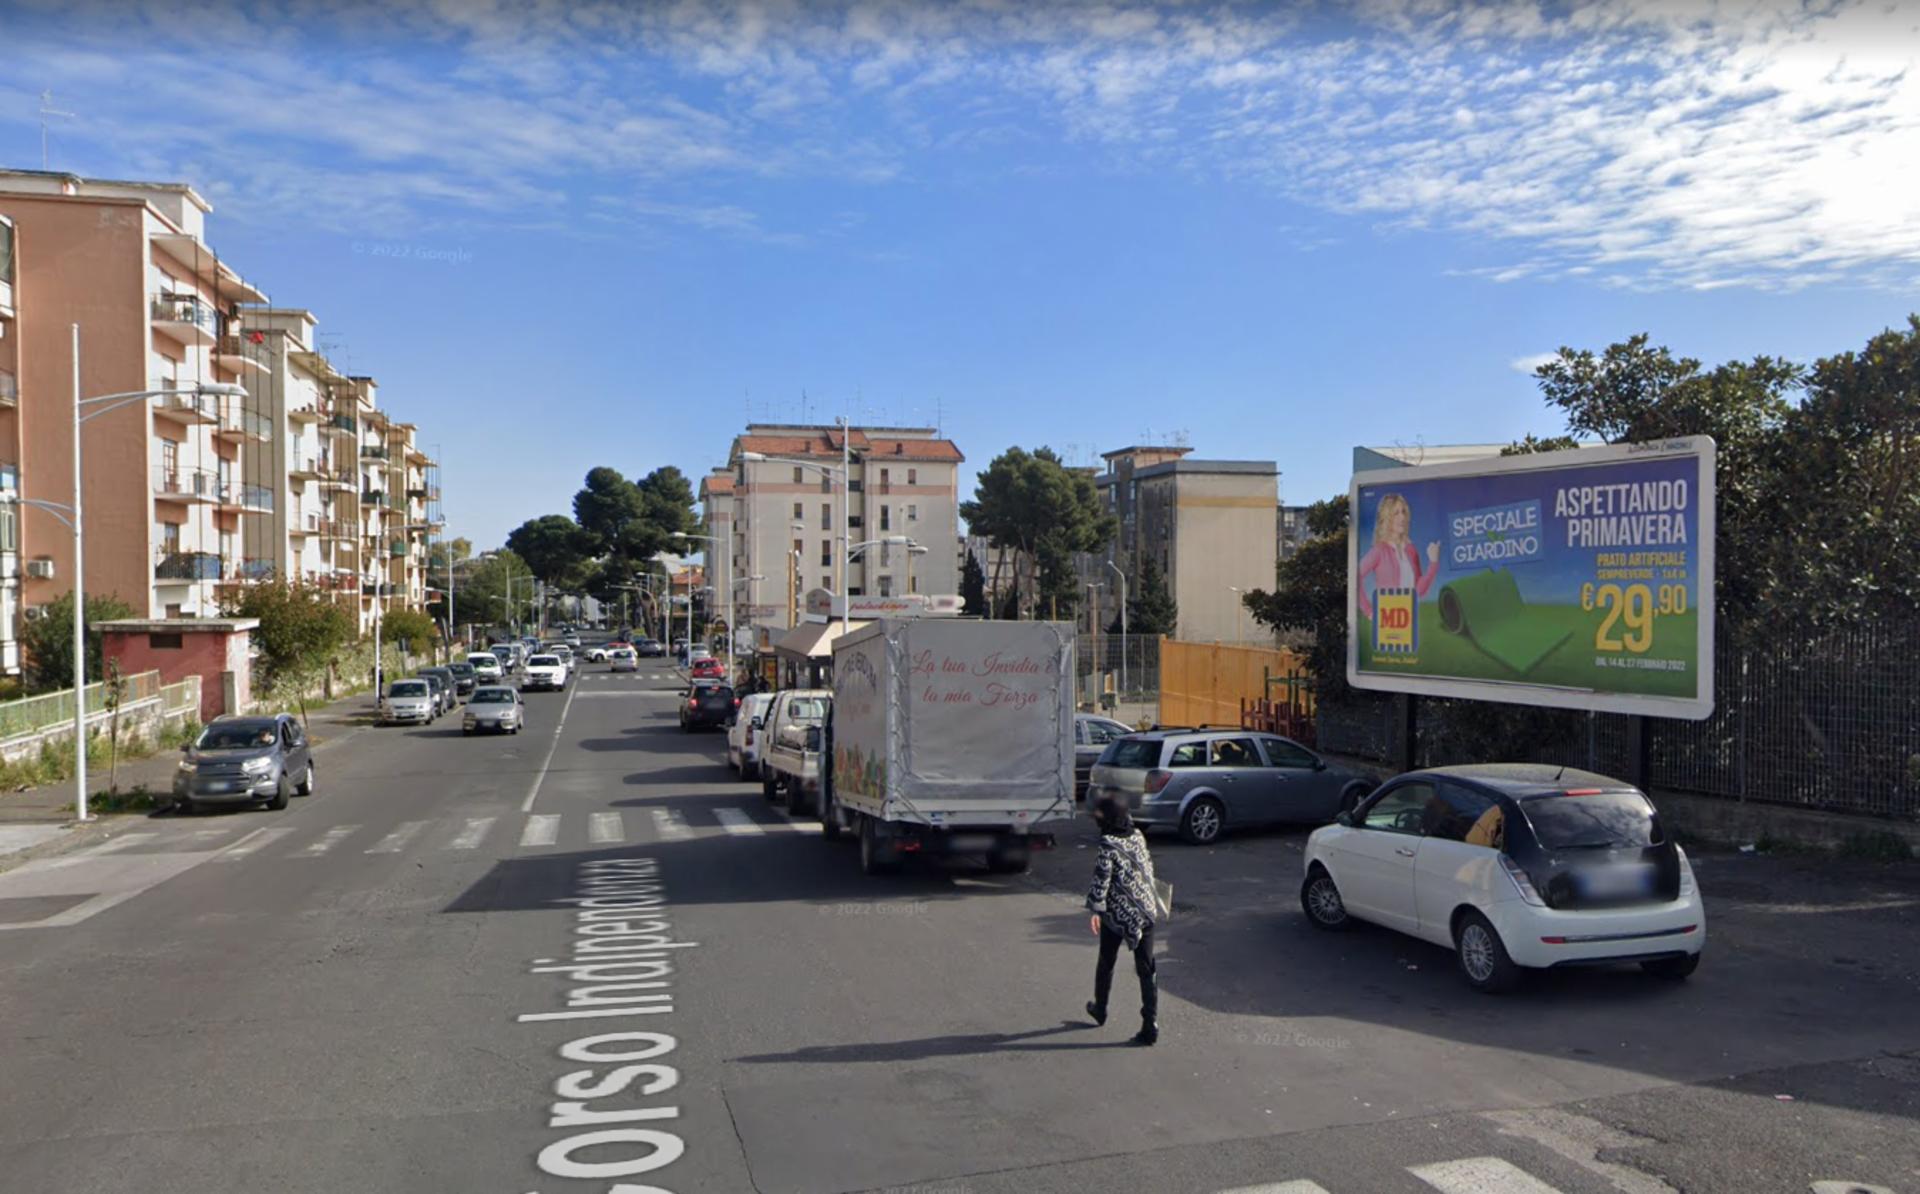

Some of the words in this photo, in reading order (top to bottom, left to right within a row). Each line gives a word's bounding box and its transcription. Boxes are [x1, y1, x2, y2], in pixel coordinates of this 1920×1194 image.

[1555, 479, 1688, 517] ASPETTANDO
[1453, 506, 1537, 538] SPECIALE
[1567, 514, 1687, 548] PRIMAVERA
[1453, 536, 1538, 563] GIARDINO
[1380, 607, 1410, 629] MD
[911, 649, 936, 679] La
[942, 657, 967, 673] tua
[971, 651, 1041, 677] Invidia
[922, 685, 938, 702] la
[943, 688, 972, 702] mia
[980, 682, 1039, 711] Forza
